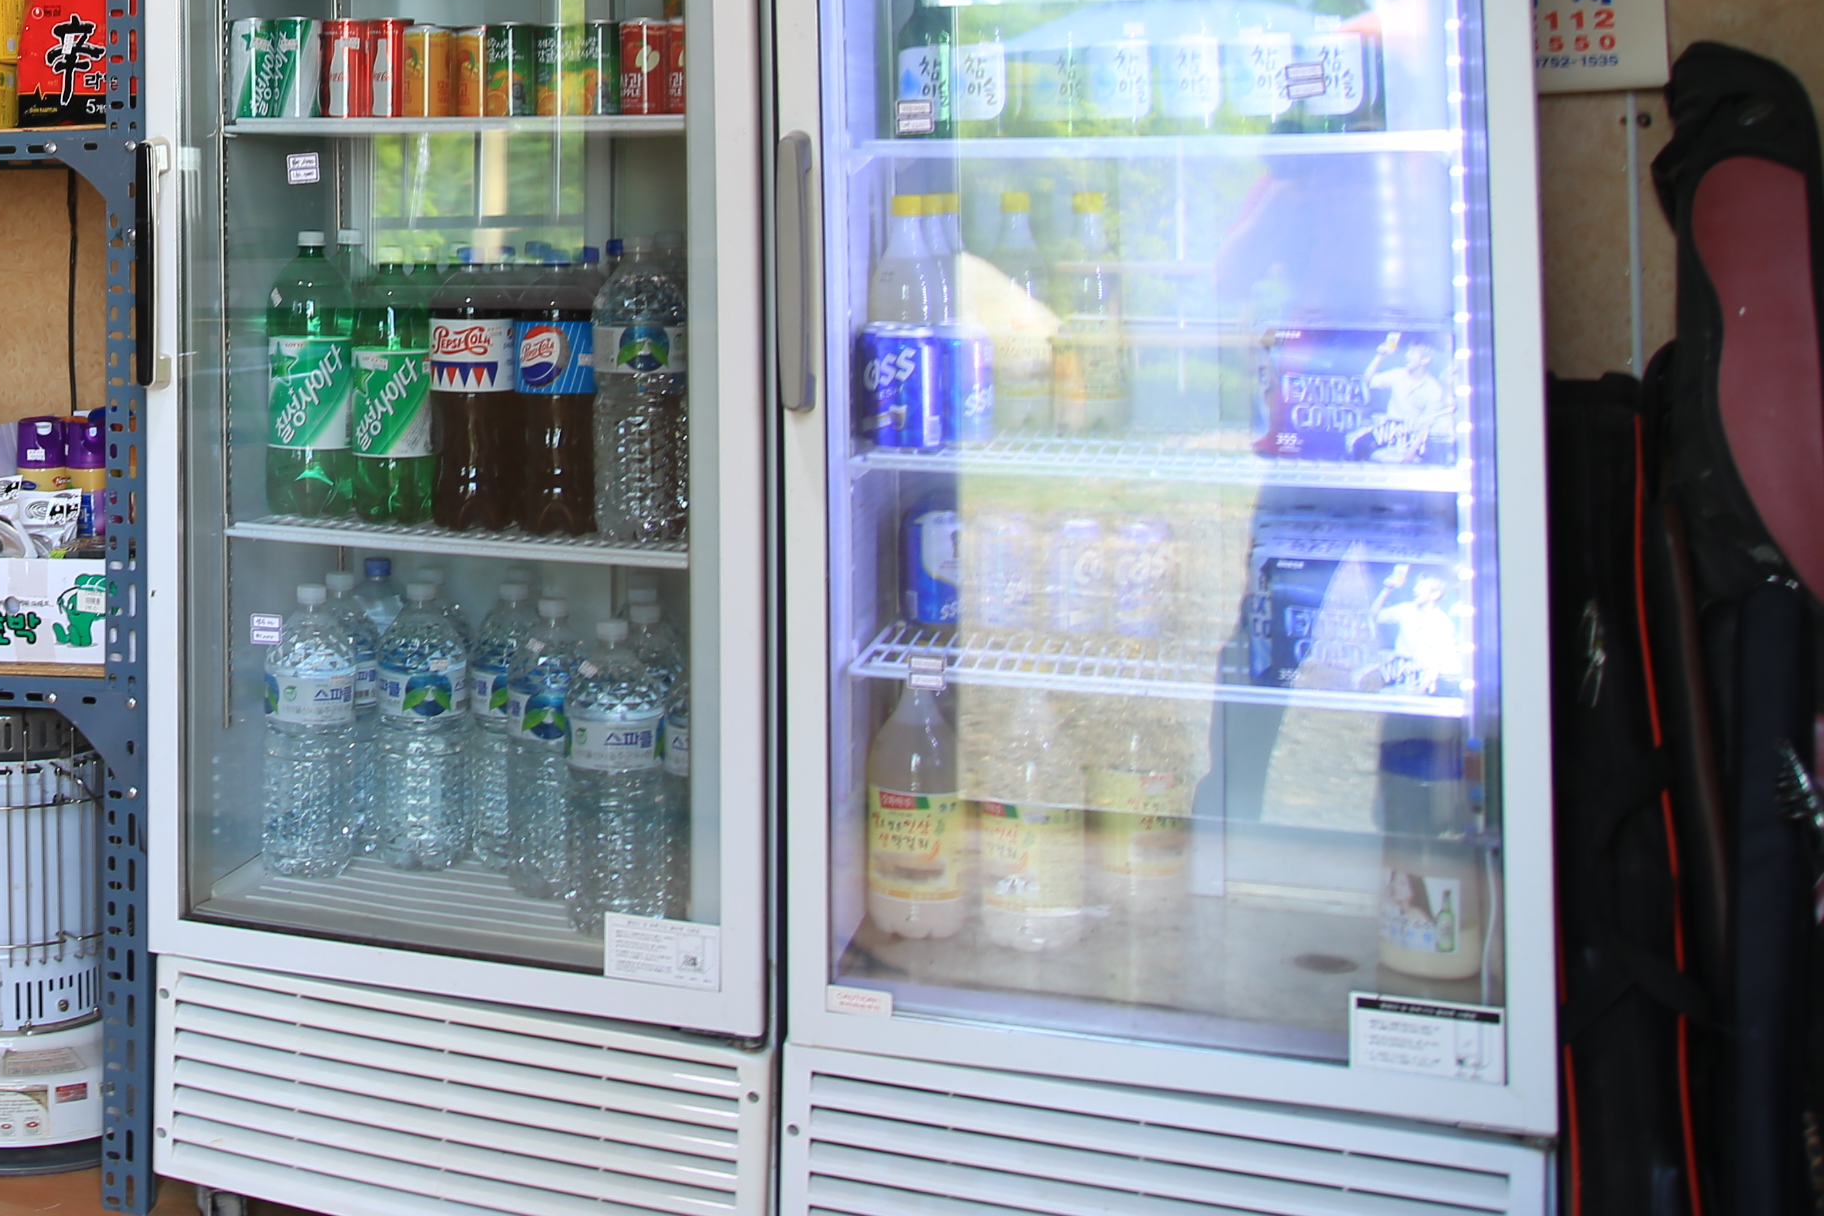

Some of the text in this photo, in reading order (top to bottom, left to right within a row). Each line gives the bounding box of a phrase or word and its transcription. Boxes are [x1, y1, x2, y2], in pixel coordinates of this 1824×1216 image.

[45, 13, 106, 106] 辛
[964, 52, 987, 79] 참
[285, 341, 304, 349] LOTTE
[276, 342, 344, 444] 칠성사이다
[355, 356, 418, 452] 칠성사이다
[1281, 372, 1372, 406] EXTRA
[1290, 403, 1362, 433] COLD
[314, 685, 352, 703] 스파클
[603, 729, 653, 749] 스파클
